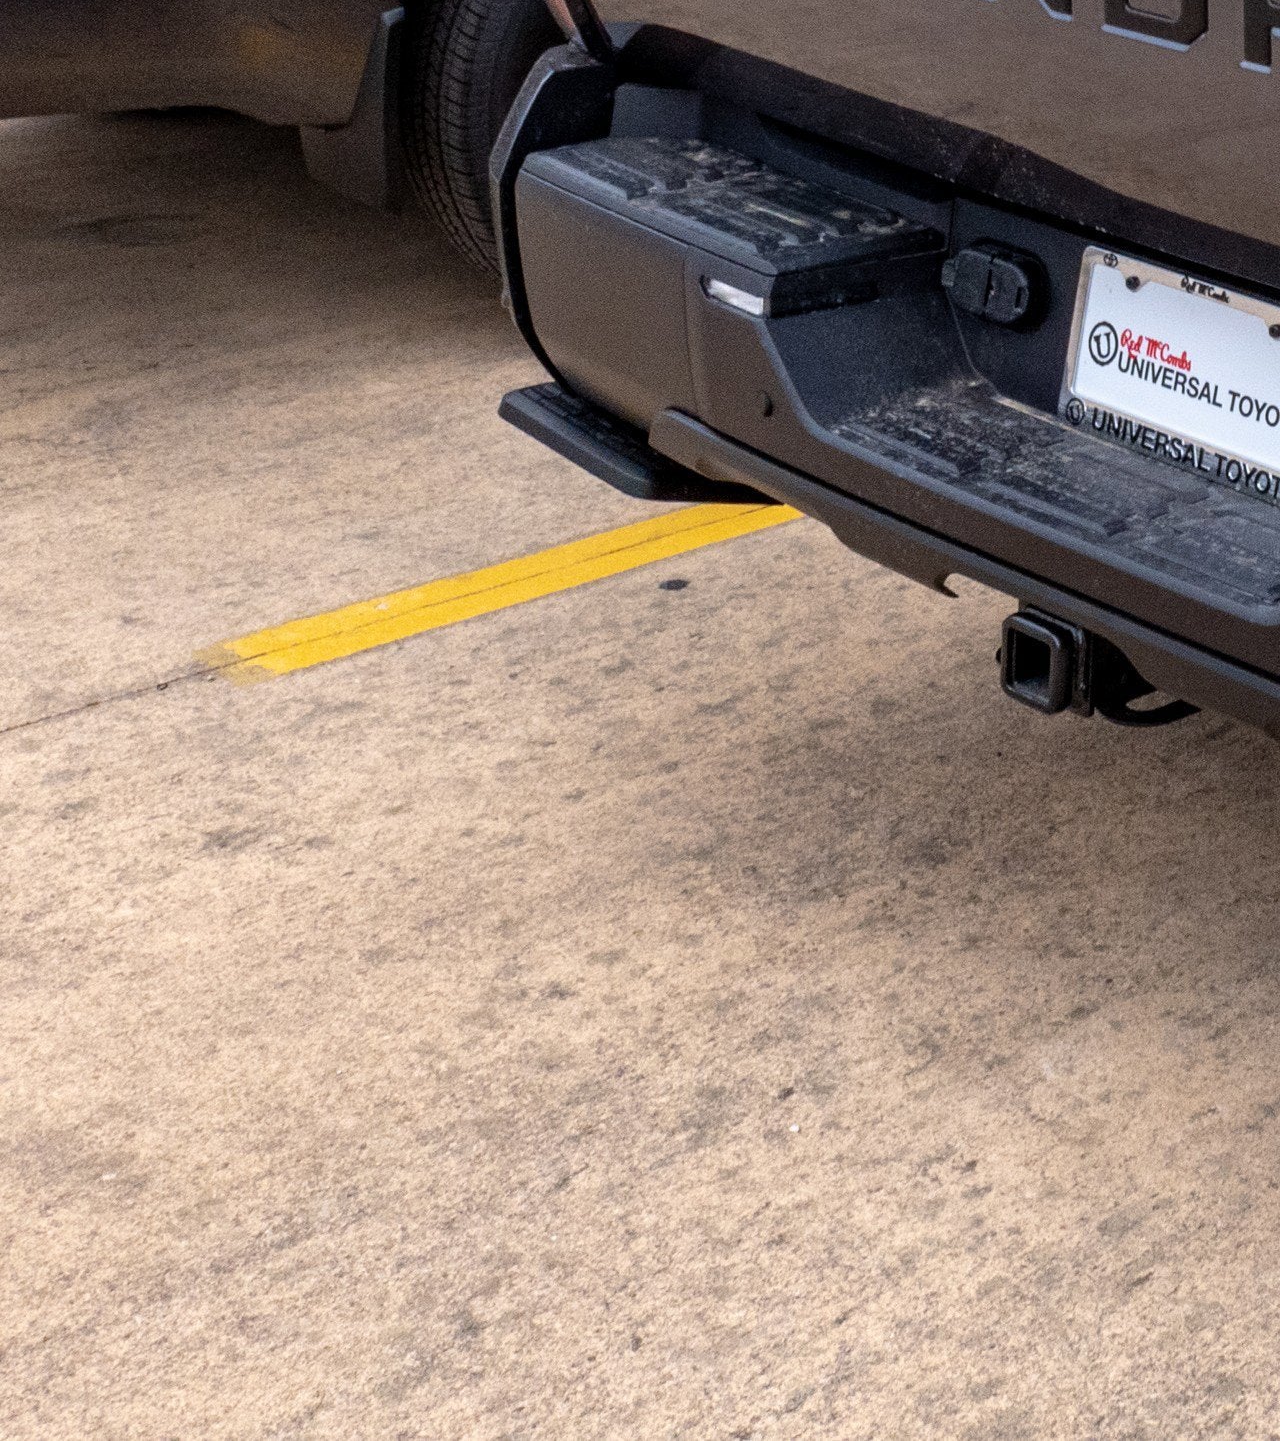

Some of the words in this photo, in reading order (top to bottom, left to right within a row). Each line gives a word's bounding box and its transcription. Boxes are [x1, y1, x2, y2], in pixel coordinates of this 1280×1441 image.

[1120, 328, 1143, 359] Red
[1145, 336, 1191, 371] McCombs
[1118, 350, 1223, 408] UNIVERSAL
[1091, 407, 1210, 472] UNIVERSAL
